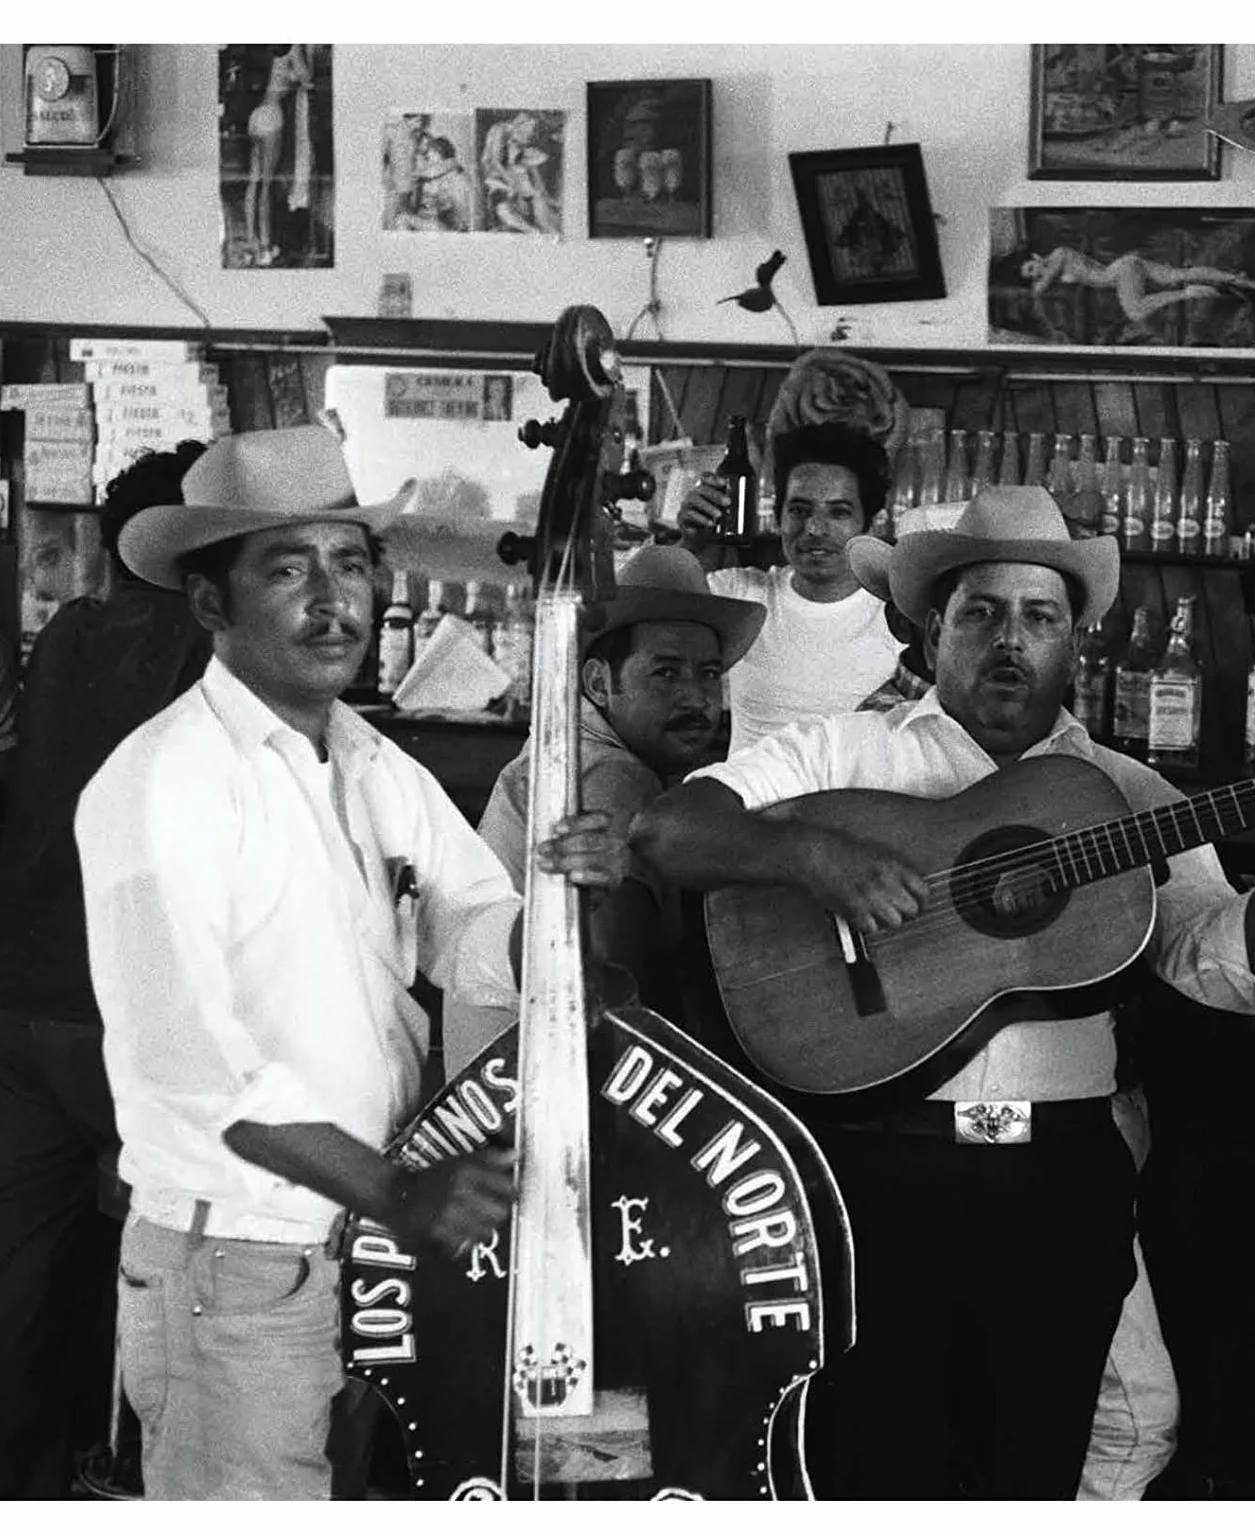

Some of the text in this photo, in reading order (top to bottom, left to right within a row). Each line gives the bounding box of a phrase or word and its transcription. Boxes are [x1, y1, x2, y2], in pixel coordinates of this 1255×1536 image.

[351, 1278, 417, 1364] LOS
[601, 1045, 704, 1148] DEL
[690, 1119, 811, 1333] NORTE
